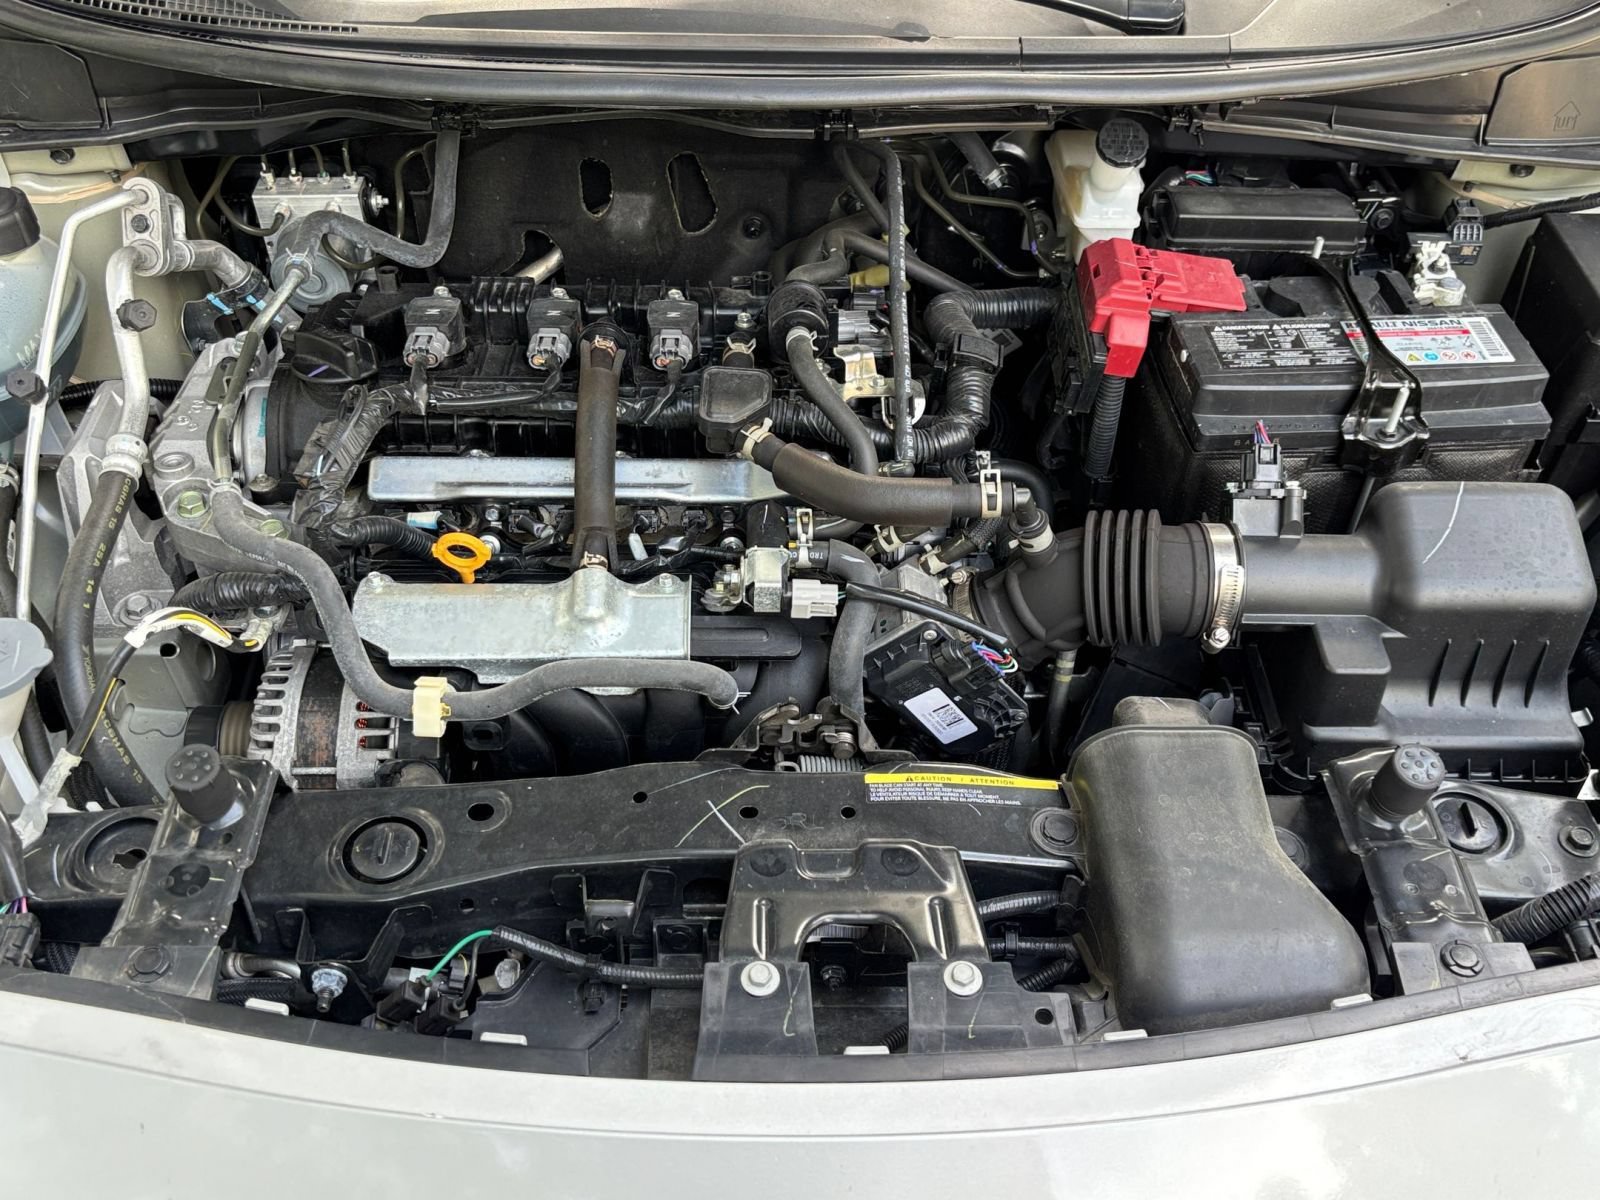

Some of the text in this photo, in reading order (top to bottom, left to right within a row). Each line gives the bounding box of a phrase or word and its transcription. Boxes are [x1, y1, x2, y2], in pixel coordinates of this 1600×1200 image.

[1402, 319, 1462, 327] NISSAN
[114, 474, 132, 514] CGHAS
[132, 768, 144, 784] 15
